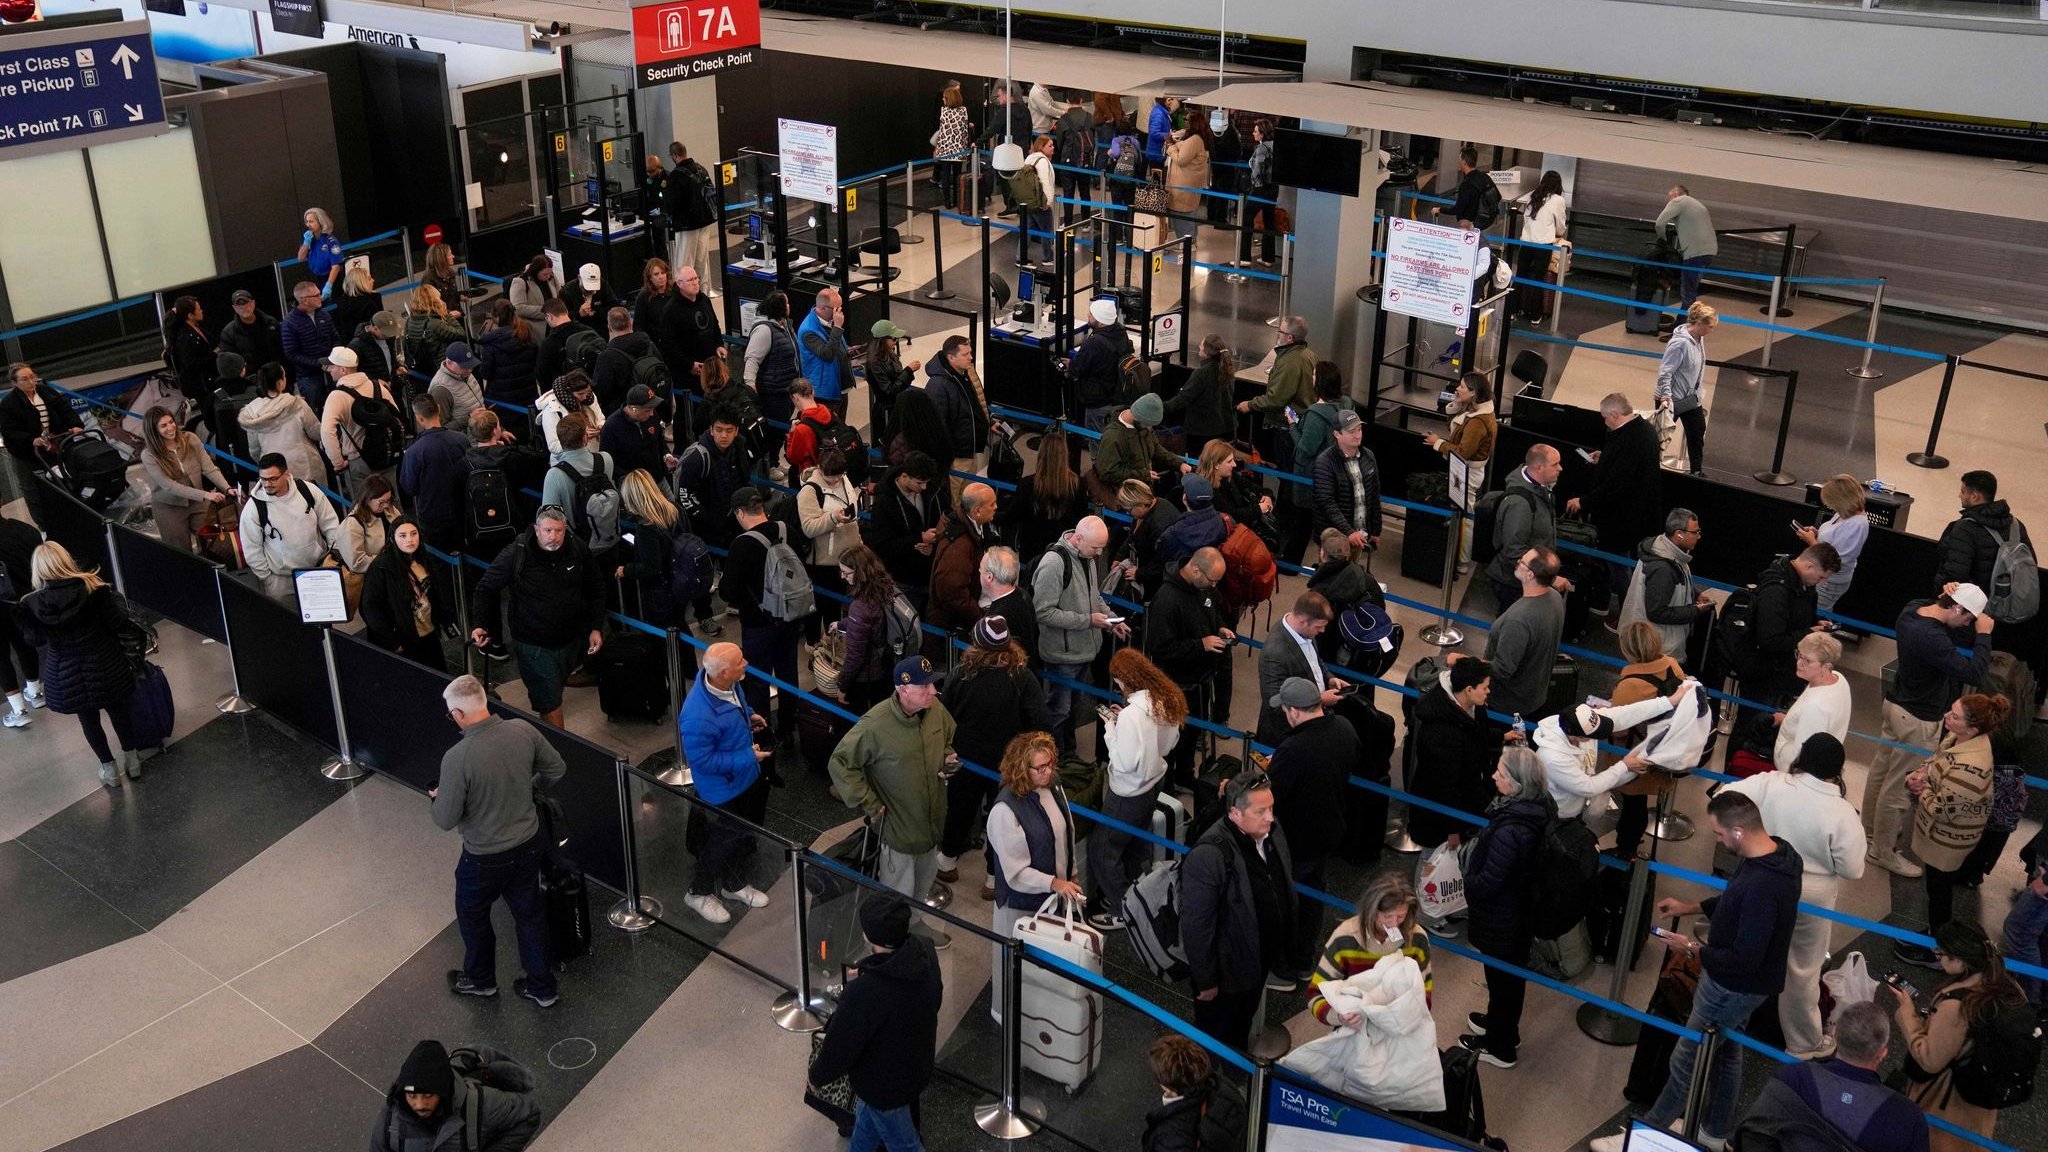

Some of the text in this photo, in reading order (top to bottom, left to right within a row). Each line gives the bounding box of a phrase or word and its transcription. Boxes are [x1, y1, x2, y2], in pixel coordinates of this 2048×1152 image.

[274, 0, 298, 10] FLAGSHIP
[698, 6, 736, 41] 7A
[348, 25, 404, 48] American
[25, 56, 70, 72] Class
[647, 52, 752, 81] Security Check Point
[0, 76, 74, 97] re Pickup
[18, 119, 60, 137] Point
[62, 115, 84, 129] 7A
[557, 138, 563, 149] 6
[605, 148, 611, 160] 6
[724, 170, 731, 183] 5
[848, 195, 855, 208] 4
[1419, 226, 1450, 237] ATTENTION
[1154, 257, 1161, 272] 2
[1400, 256, 1427, 266] FIREARMS
[1442, 264, 1470, 275] ALLOWED
[1435, 270, 1452, 279] POINT
[1482, 318, 1486, 334] 1
[1440, 878, 1463, 897] Webe
[1441, 893, 1463, 904] RESTA
[1280, 1087, 1330, 1115] TSA Pre
[1281, 1101, 1338, 1127] Travel With Ease
